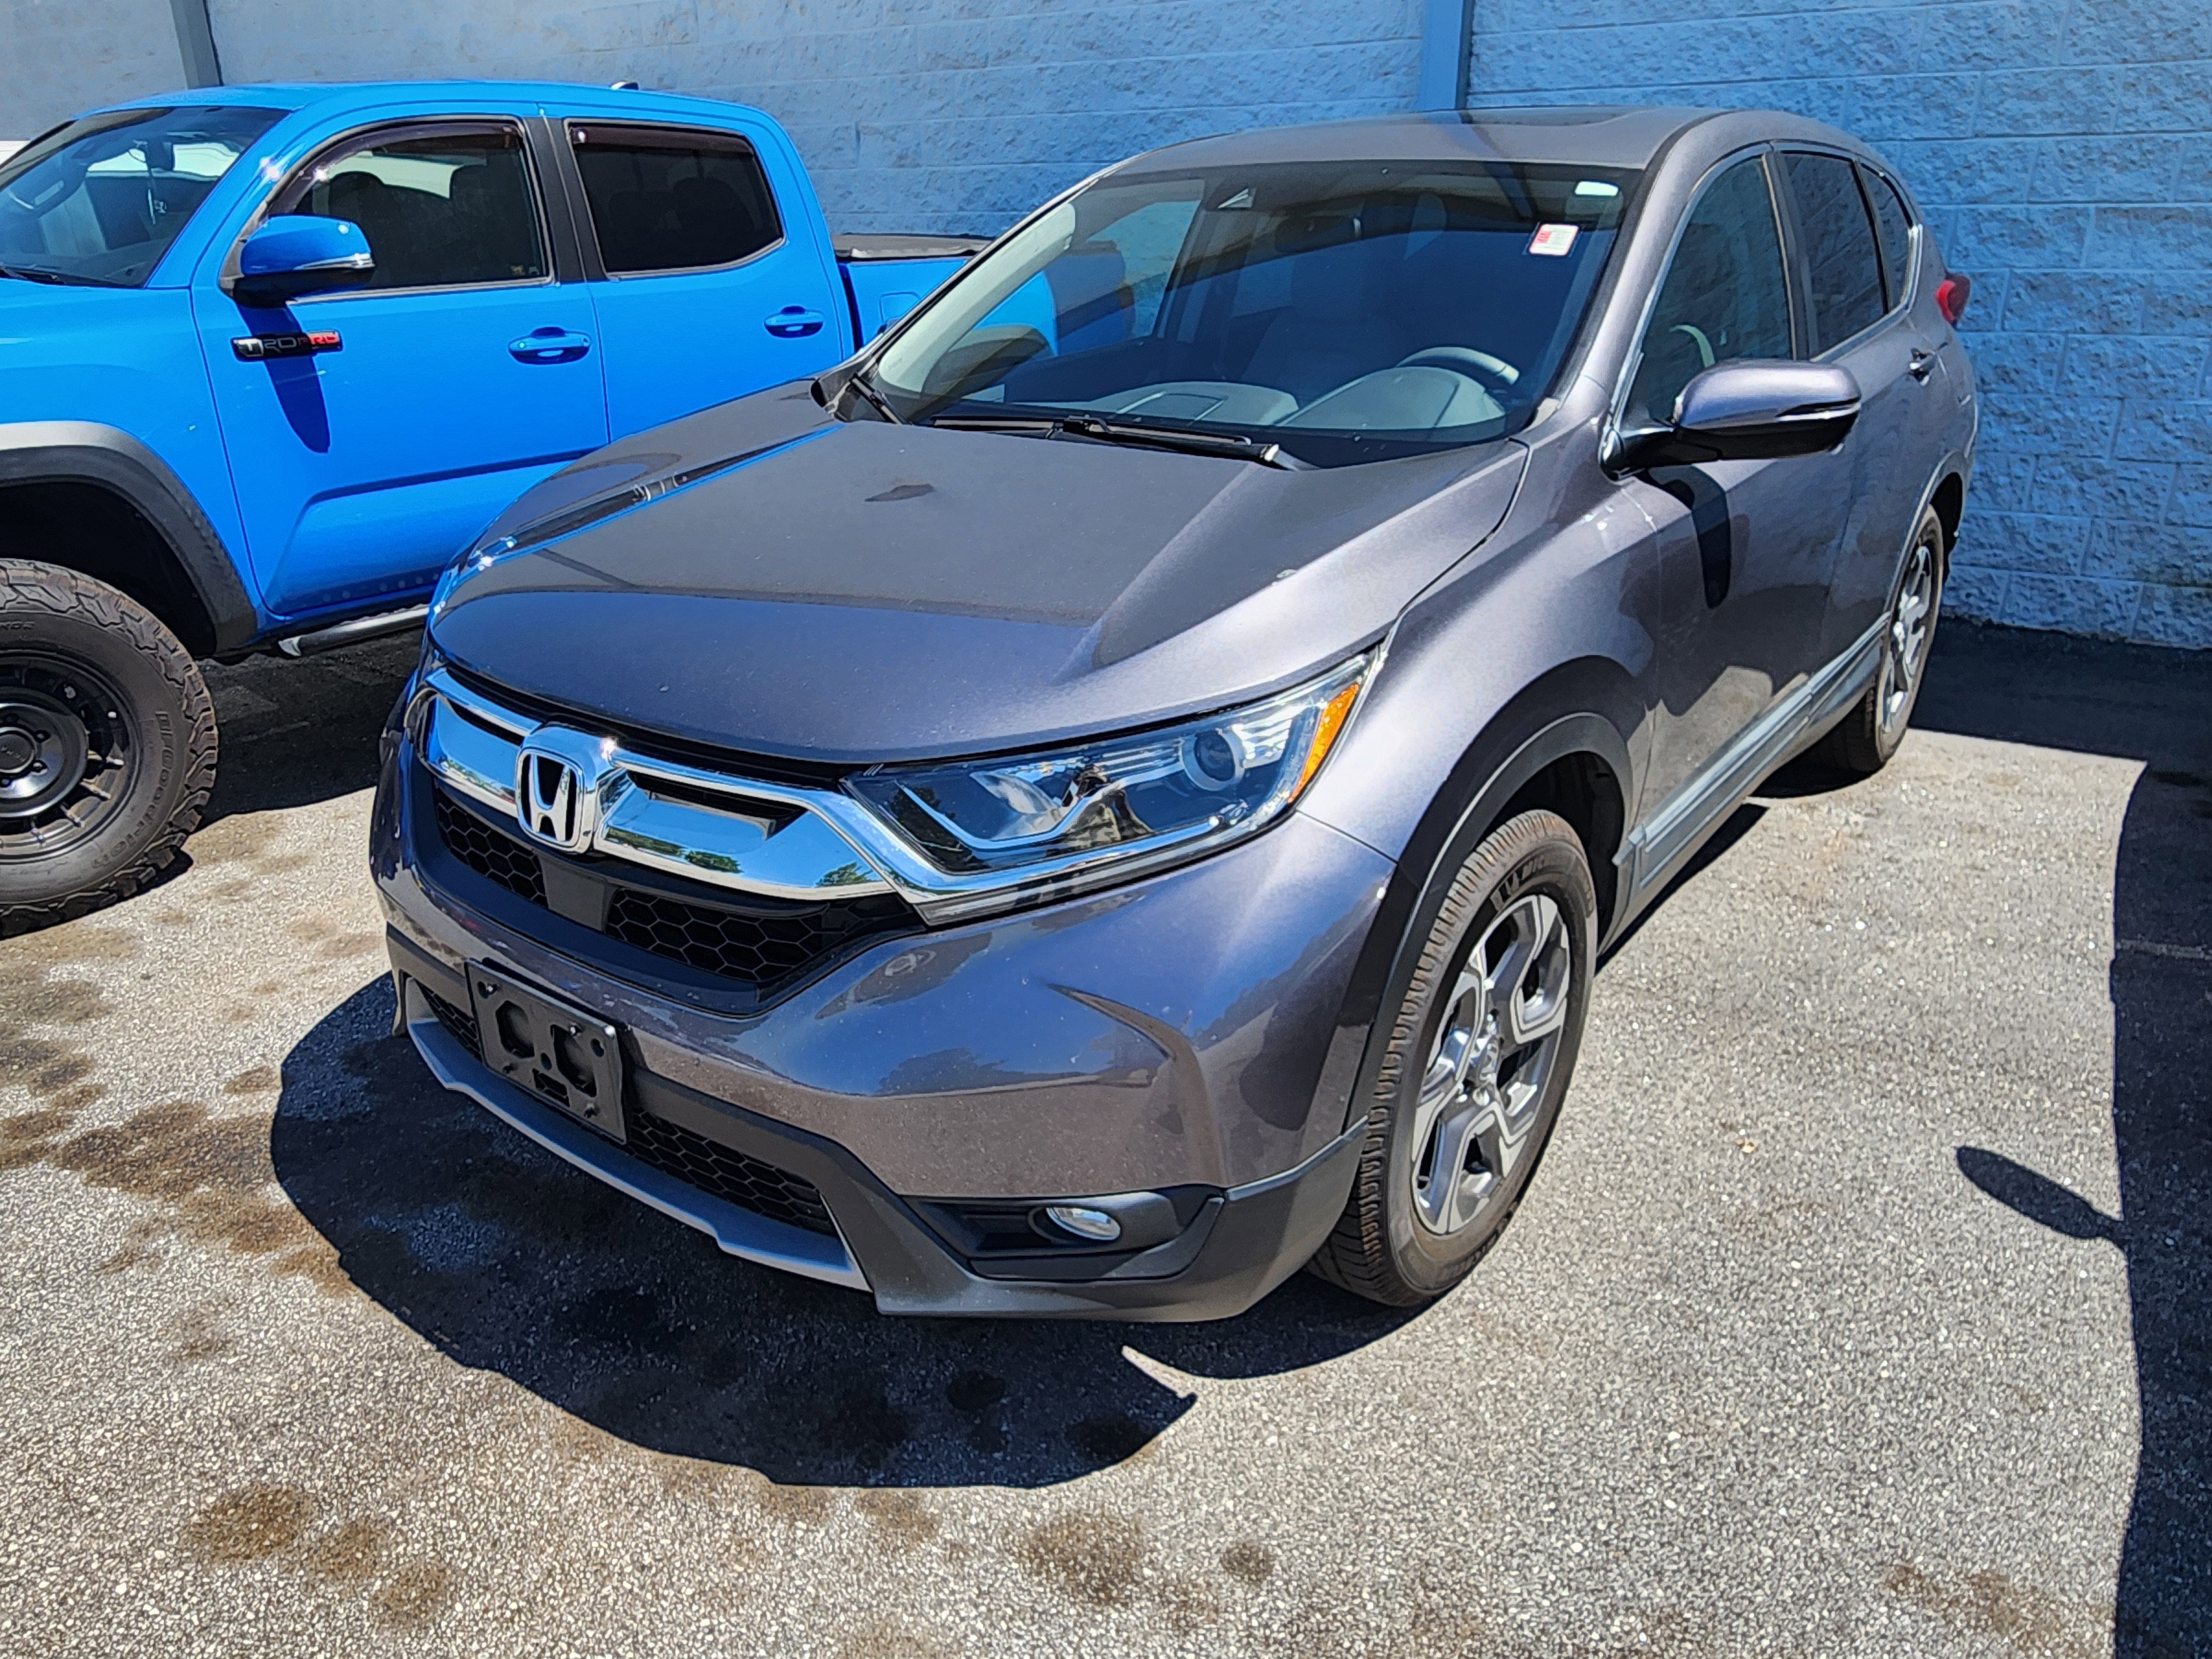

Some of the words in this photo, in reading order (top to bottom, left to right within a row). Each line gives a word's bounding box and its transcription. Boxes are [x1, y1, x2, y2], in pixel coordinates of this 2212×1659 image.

[233, 337, 298, 357] TRD
[297, 335, 337, 346] PRO
[91, 709, 174, 869] BFGoodrich
